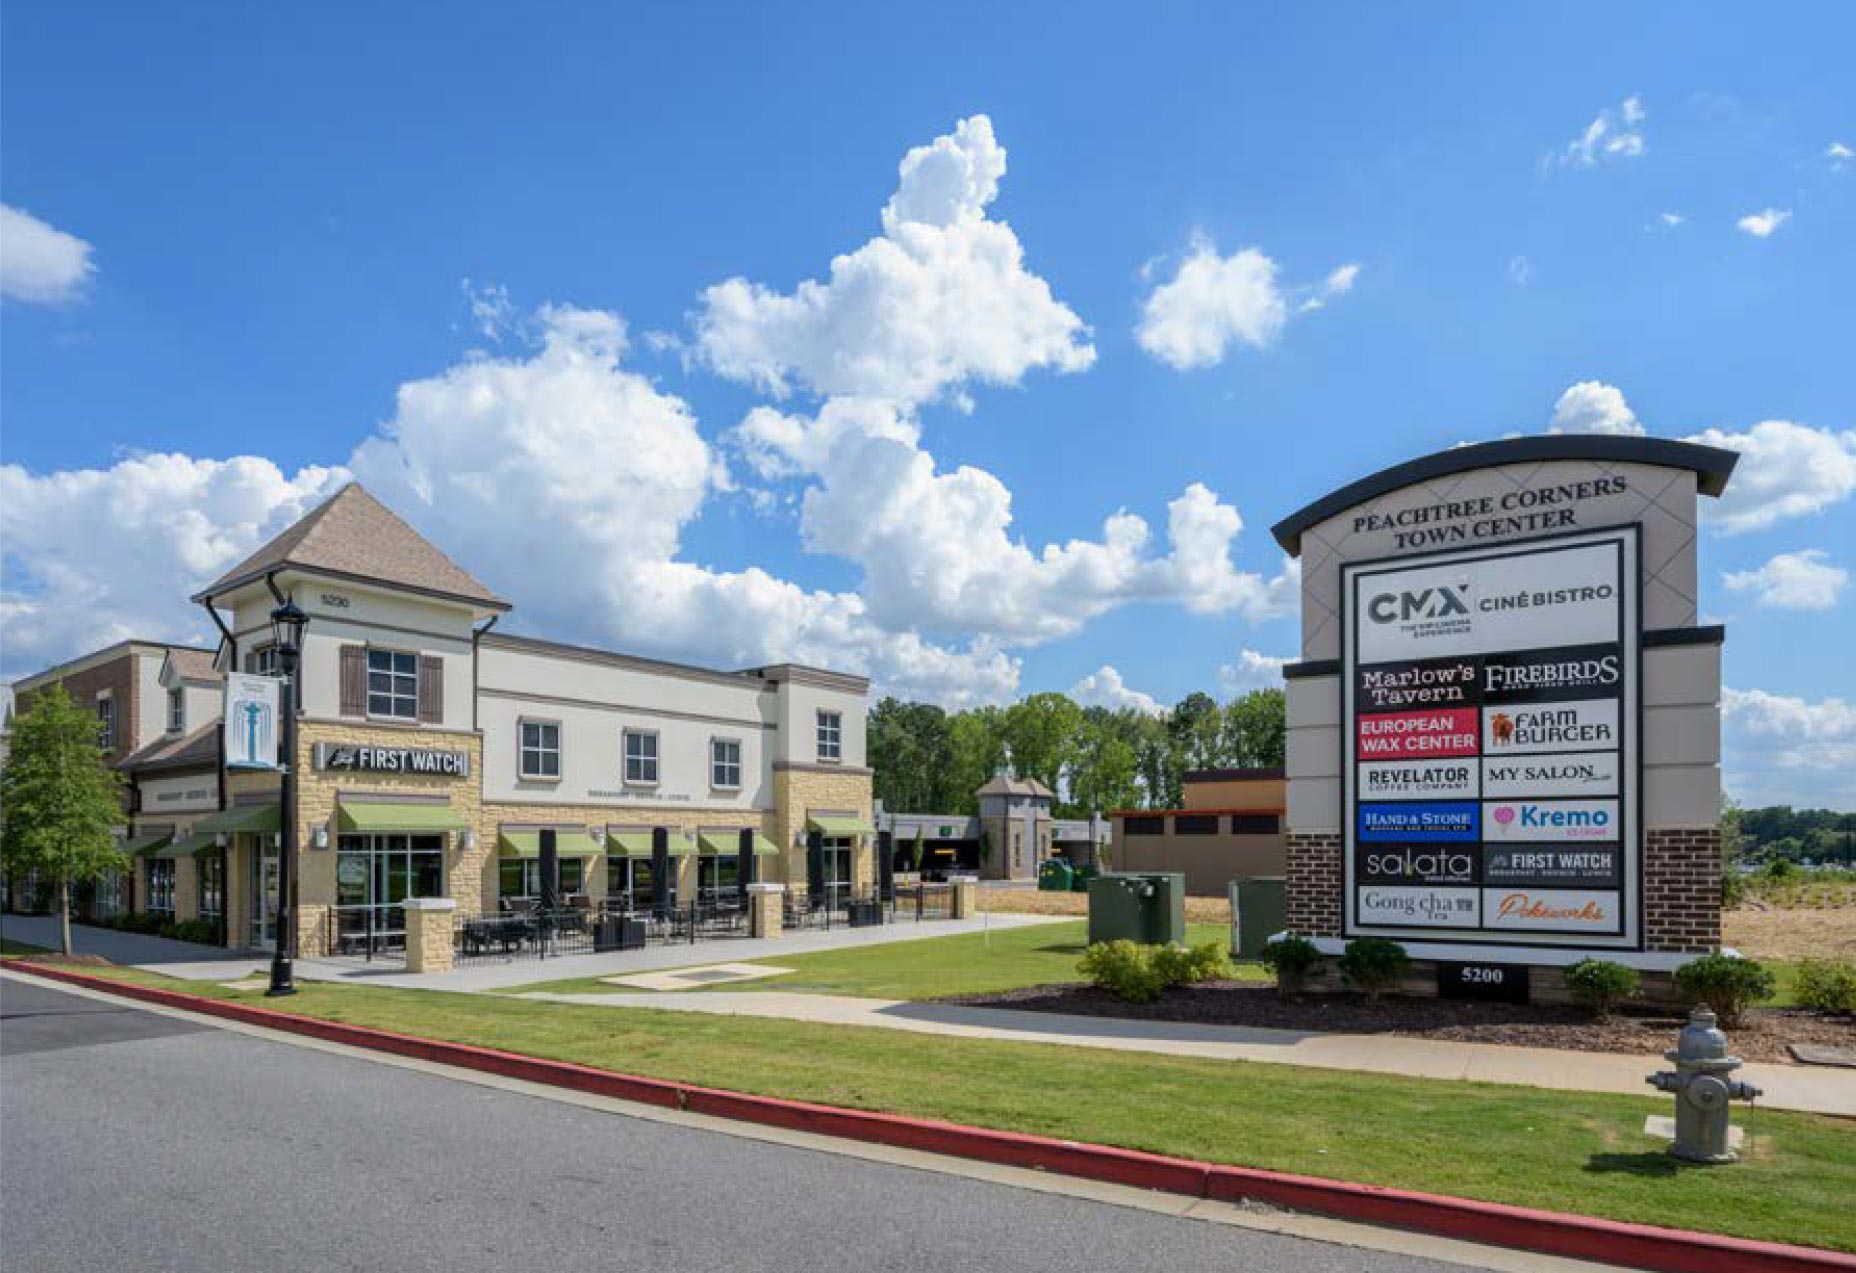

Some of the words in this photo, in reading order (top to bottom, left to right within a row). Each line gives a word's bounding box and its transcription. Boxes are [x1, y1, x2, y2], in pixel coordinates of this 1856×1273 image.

[1353, 496, 1494, 533] PEACHTREE
[1501, 476, 1627, 511] CORNERS
[1394, 523, 1466, 550] TOWN
[1473, 509, 1577, 538] CENTER
[1367, 583, 1470, 625] CMX
[1362, 663, 1475, 690] Marlow's
[1484, 655, 1619, 692] FIREBIRDS
[1371, 686, 1464, 706] Tavern
[1361, 716, 1455, 735] EUROPEAN
[1515, 709, 1577, 728] FARM
[1361, 737, 1401, 752] WAX
[1405, 733, 1475, 751] CENTER
[1515, 723, 1611, 744] BURGER
[359, 748, 406, 771] FIRST
[411, 750, 464, 773] WATCH
[1369, 767, 1469, 784] REVELATOR
[1488, 767, 1519, 781] MY
[1524, 764, 1594, 781] SALON
[1366, 812, 1408, 825] HAND
[1421, 812, 1470, 825] STONE
[1521, 804, 1609, 827] Kremo
[1367, 847, 1471, 877] salata
[1511, 854, 1554, 868] FIRST
[1559, 854, 1612, 868] WATCH
[1365, 892, 1415, 916] Gong
[1419, 891, 1452, 912] cha
[1461, 966, 1504, 984] 5200
